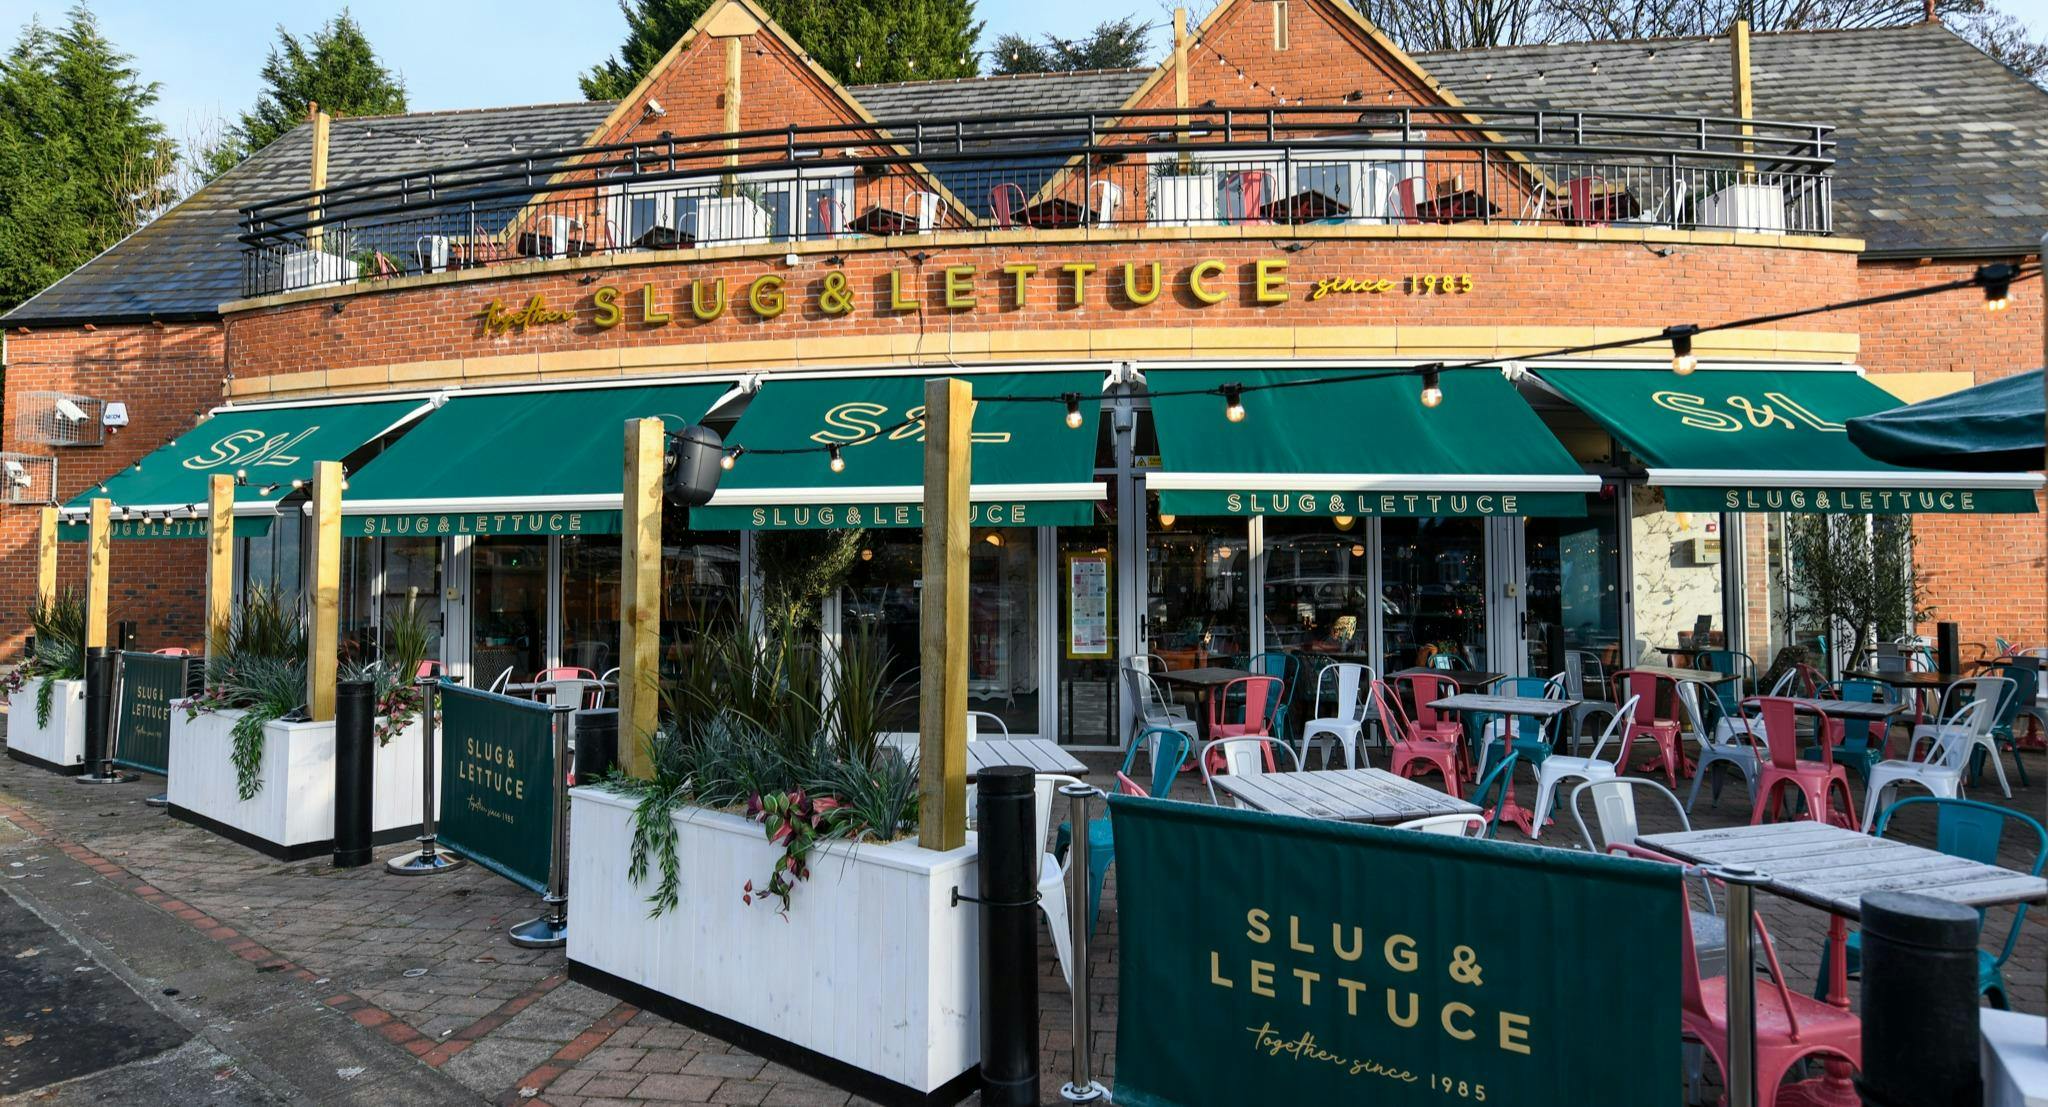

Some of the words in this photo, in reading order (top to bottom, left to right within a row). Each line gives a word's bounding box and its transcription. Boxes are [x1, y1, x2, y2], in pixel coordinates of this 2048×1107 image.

[481, 294, 576, 335] together
[594, 274, 786, 328] SLUG
[819, 271, 855, 315] &
[891, 259, 1290, 310] LETTUCE
[1313, 275, 1396, 299] since
[1411, 273, 1474, 293] 1985
[1652, 390, 1847, 432] S&L
[183, 426, 320, 469] S&L
[752, 507, 834, 526] SLUG
[846, 507, 861, 525] &
[874, 505, 1026, 524] LEUCE
[1227, 494, 1316, 512] SLUG
[1329, 494, 1345, 512] &
[1358, 495, 1517, 513] LETTUCE
[1726, 490, 1805, 509] SLUG
[1816, 491, 1831, 509] &
[1841, 491, 1975, 510] LETTUCE
[110, 521, 131, 536] UG
[151, 520, 208, 535] LETTU
[364, 516, 429, 533] SLUG
[437, 515, 450, 533] &
[459, 513, 582, 532] LETTUCE
[137, 686, 157, 700] SLUG
[132, 703, 168, 720] LETTUCE
[467, 737, 503, 764] SLUG
[507, 749, 515, 768] &
[459, 760, 523, 799] LETTUCE
[1246, 908, 1418, 972] SLUG
[1449, 945, 1483, 986] &
[1211, 951, 1531, 1055] LETTUCE
[1246, 1022, 1346, 1060] together
[1350, 1057, 1418, 1082] since
[1432, 1074, 1486, 1101] 1985
